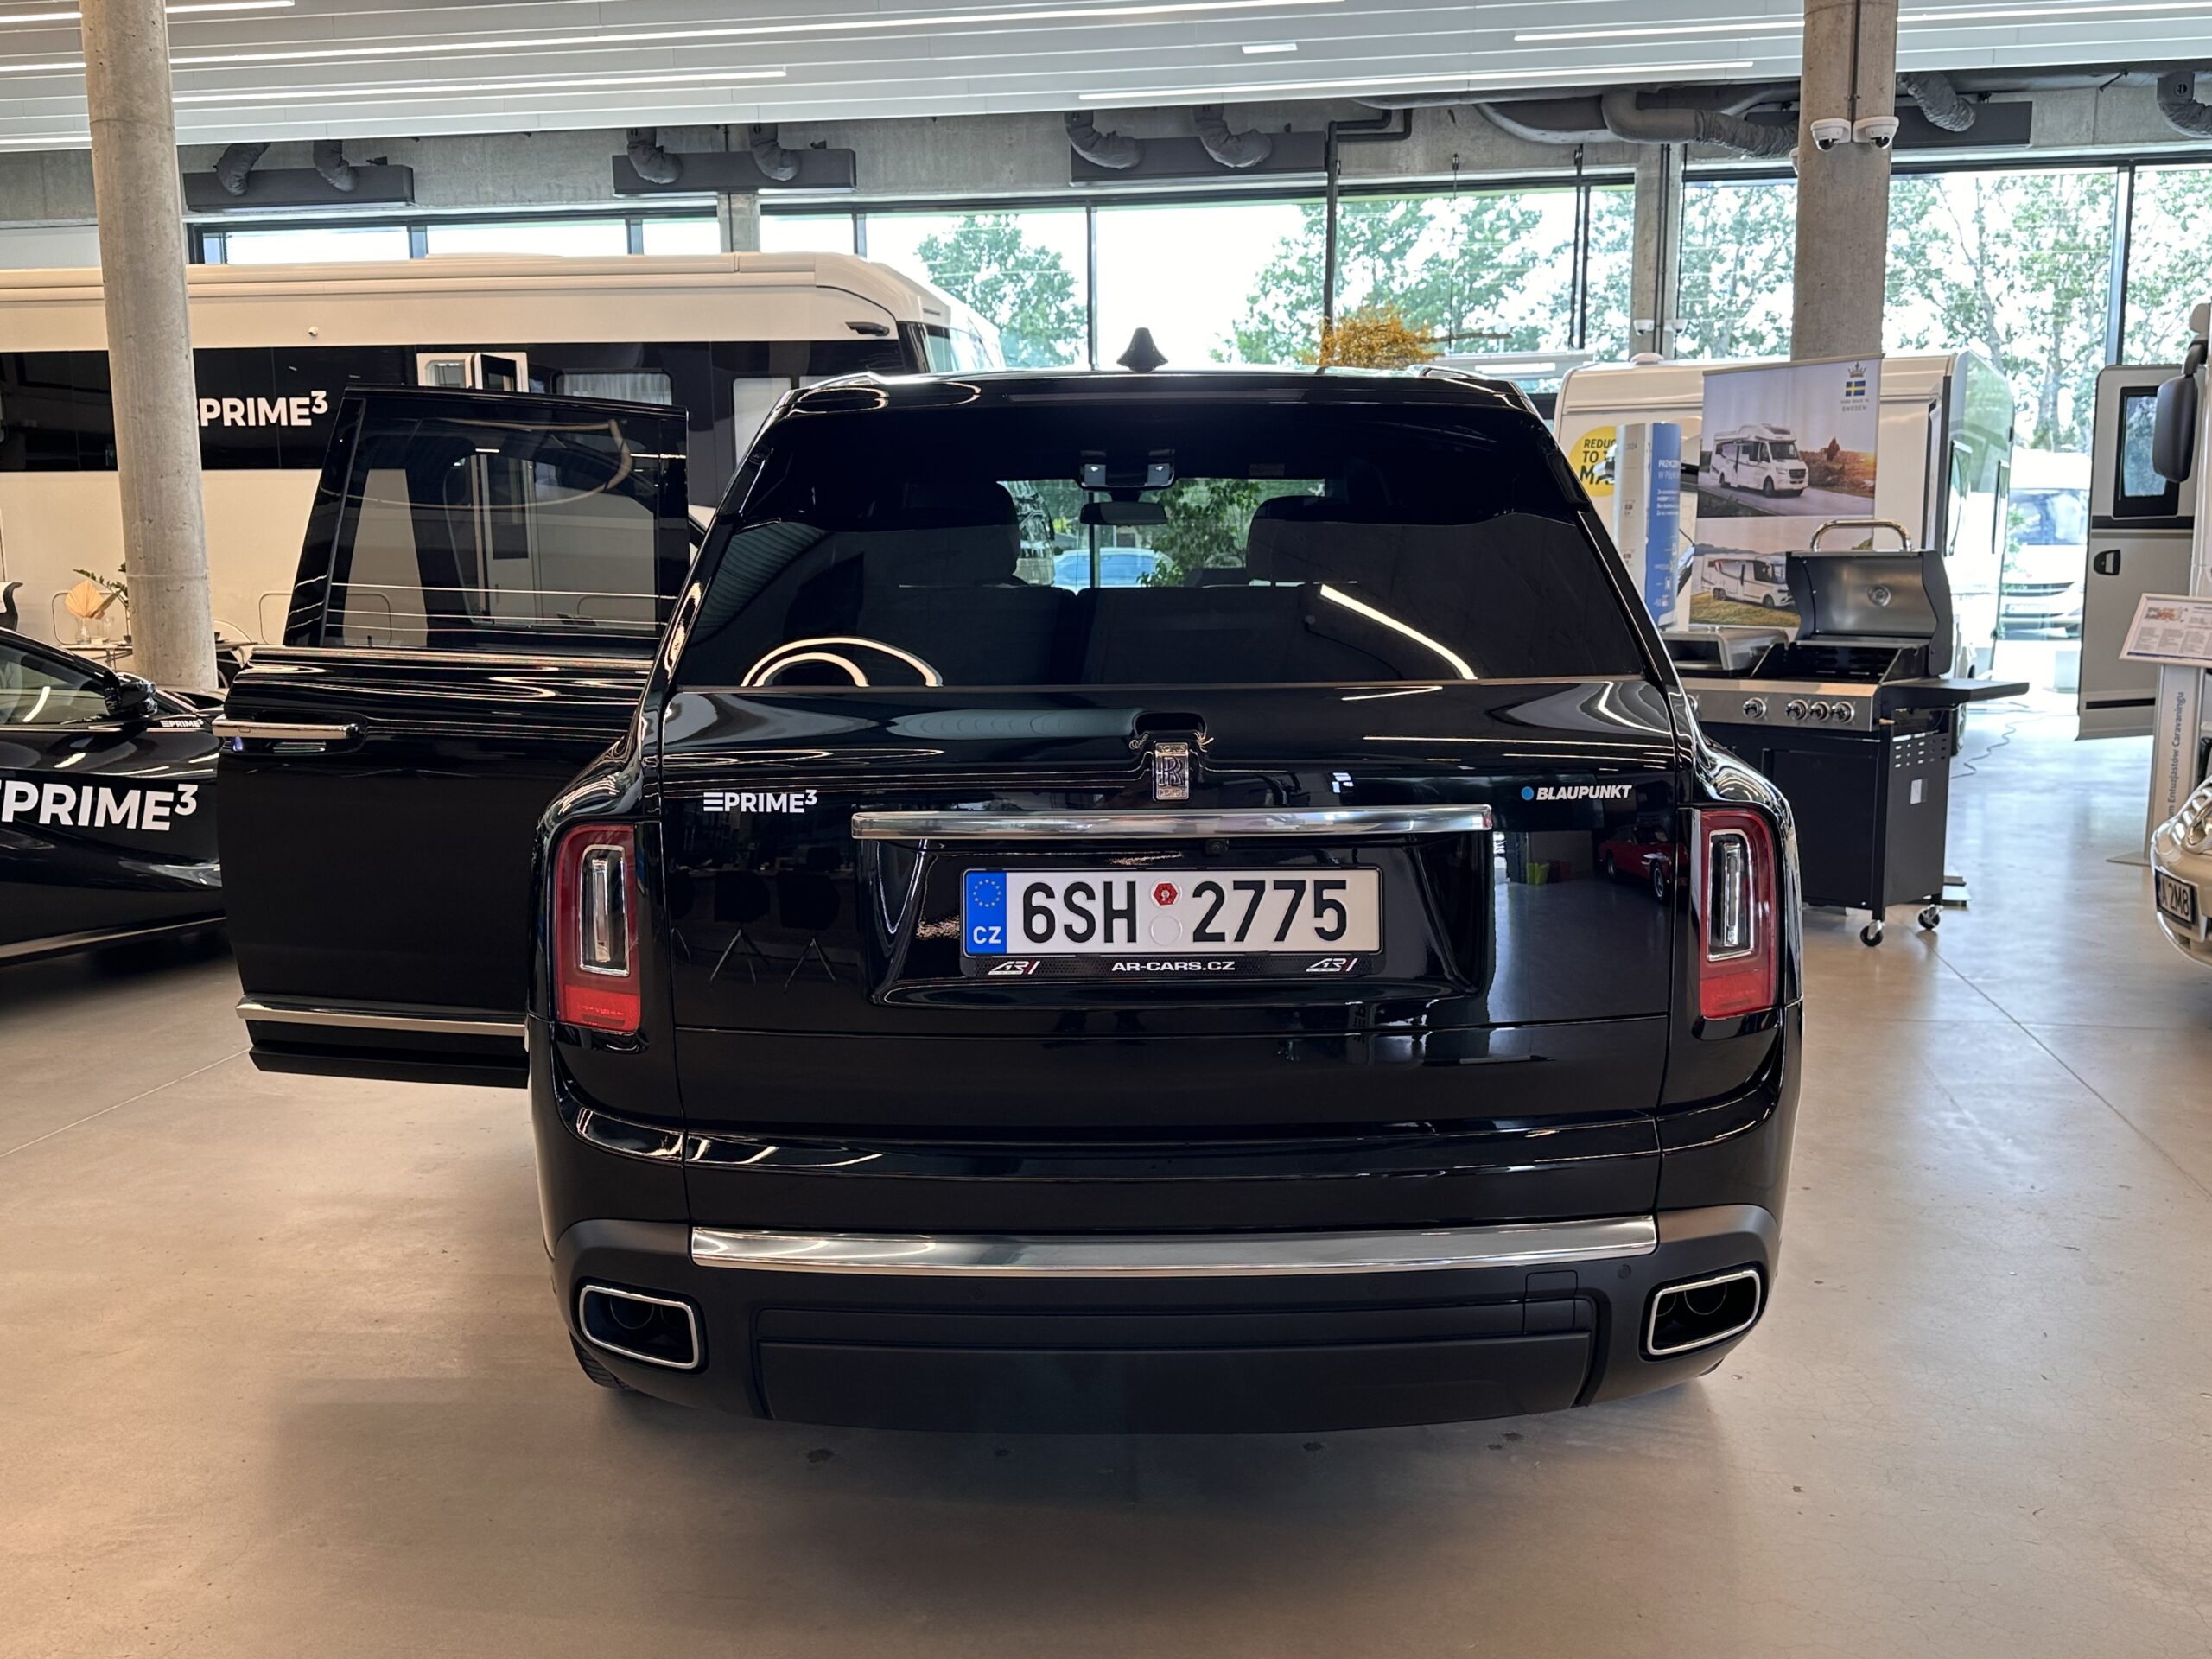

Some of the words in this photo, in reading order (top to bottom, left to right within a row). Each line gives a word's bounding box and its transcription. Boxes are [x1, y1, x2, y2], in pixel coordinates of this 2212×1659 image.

[1582, 450, 1599, 463] TO
[2171, 692, 2185, 747] Caravaningu
[2167, 750, 2180, 802] Entuzjastów
[1535, 785, 1632, 801] BLAUPUNKT
[1023, 880, 1137, 944] 6SH
[1192, 880, 1347, 943] 2775
[973, 926, 1001, 944] CZ
[1111, 960, 1236, 972] AR-CARS.CZ
